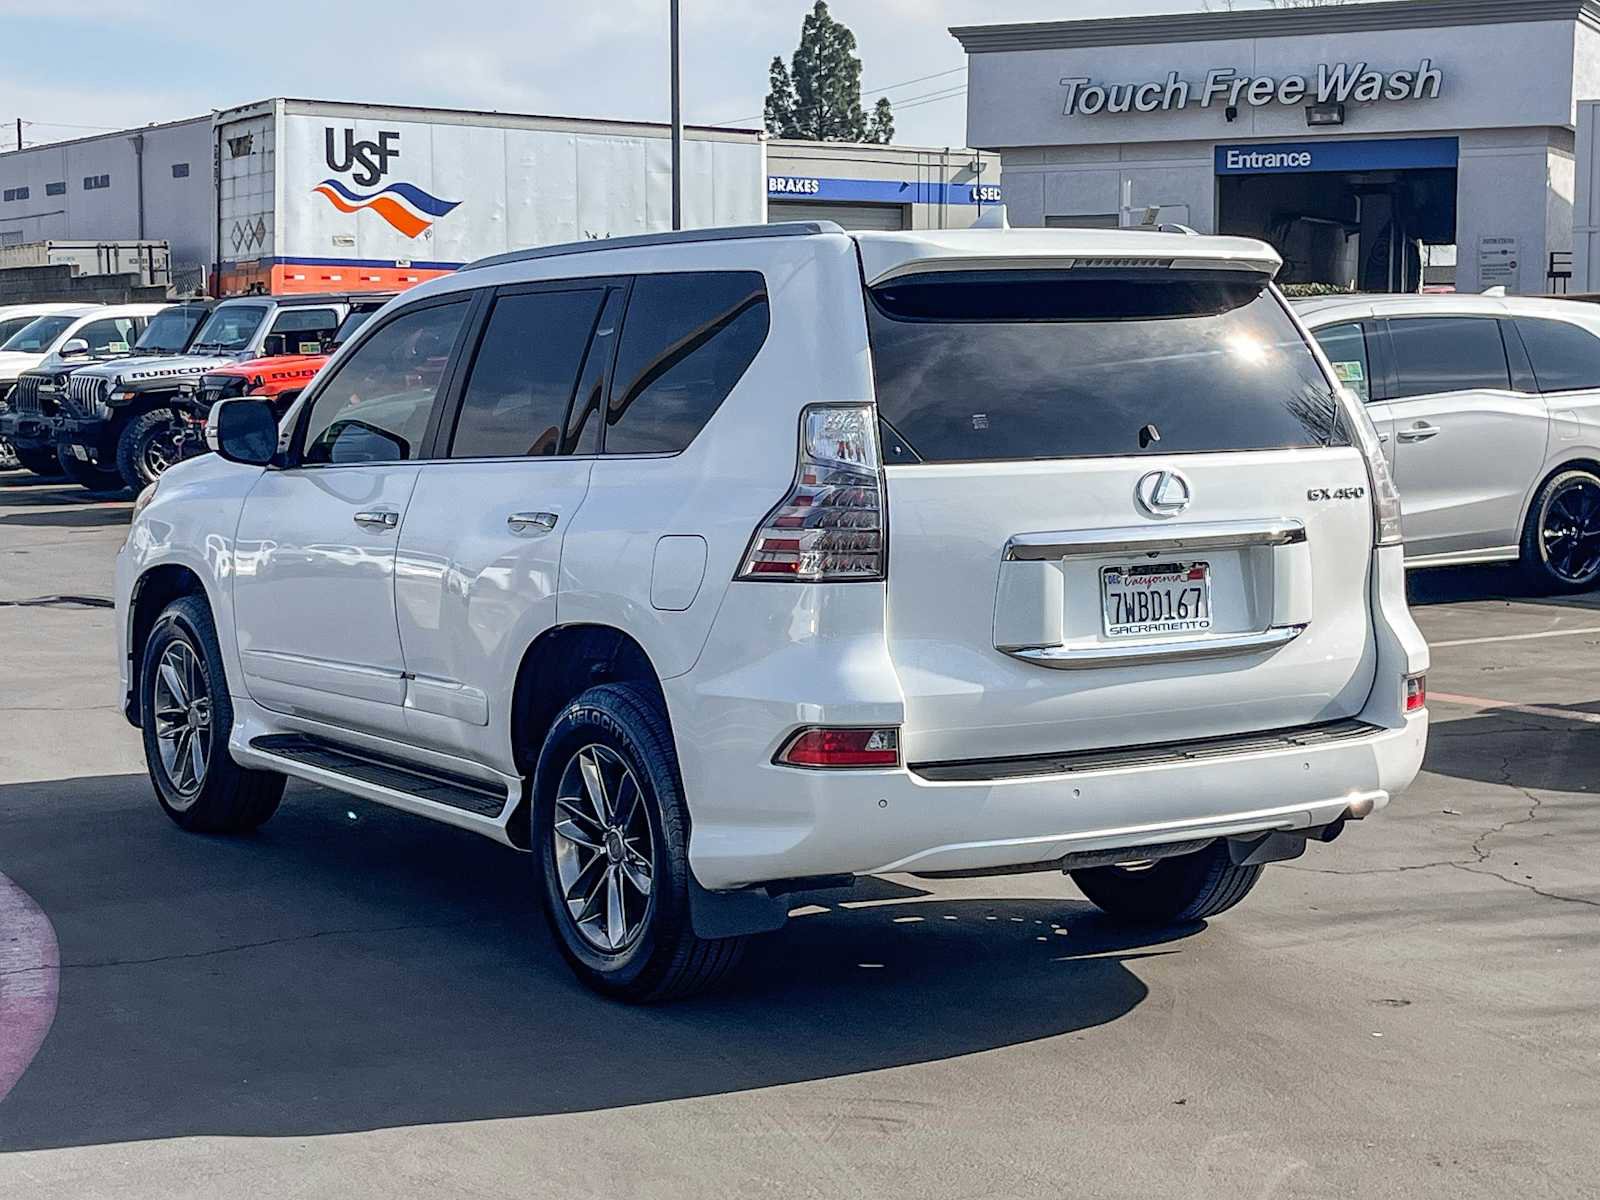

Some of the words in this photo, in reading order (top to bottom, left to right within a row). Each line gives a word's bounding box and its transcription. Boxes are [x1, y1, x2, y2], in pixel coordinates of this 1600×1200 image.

[1059, 70, 1192, 116] Touch
[1200, 67, 1305, 108] Free
[1317, 58, 1443, 103] Wash
[325, 127, 400, 187] USF
[1226, 150, 1311, 169] Entrance
[768, 177, 819, 194] BRAKES
[131, 366, 214, 379] RUBICON
[1307, 488, 1331, 501] GX
[1333, 487, 1364, 499] 460
[1110, 587, 1202, 624] 7WBD167
[1110, 621, 1210, 635] SACRAMENTO
[568, 710, 630, 747] VELOCITY
